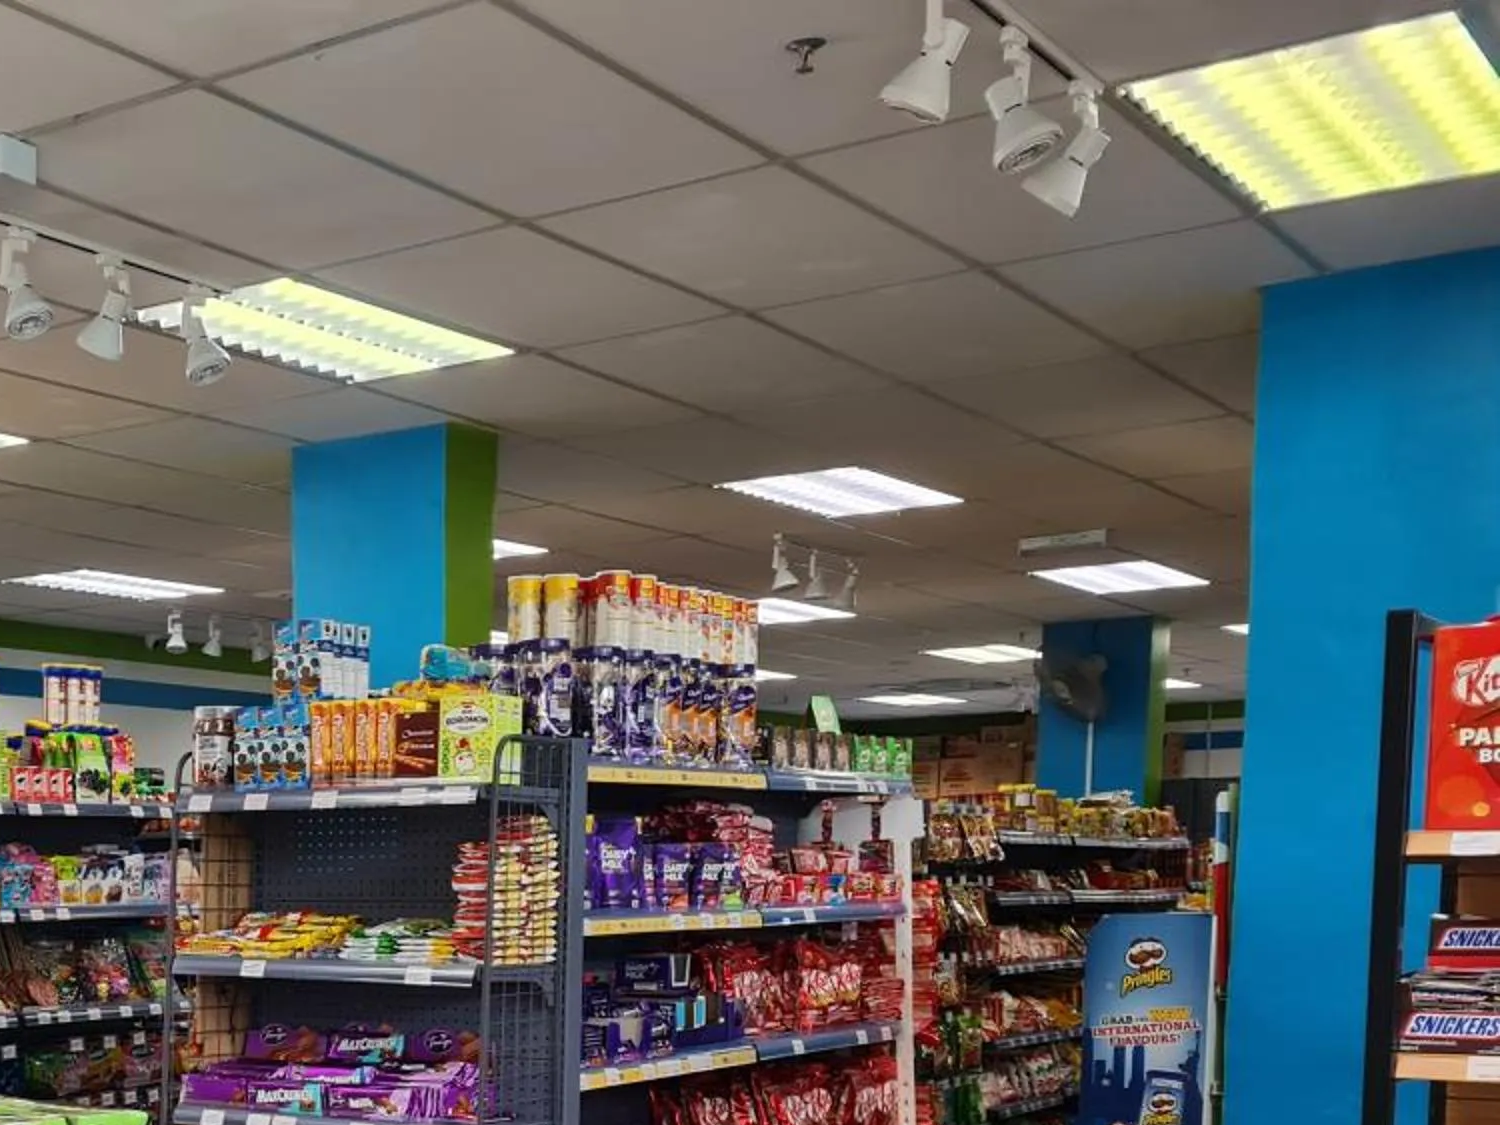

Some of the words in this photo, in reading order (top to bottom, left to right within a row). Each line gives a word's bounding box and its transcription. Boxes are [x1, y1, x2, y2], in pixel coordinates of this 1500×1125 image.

[1121, 967, 1172, 997] Pringles
[1093, 1020, 1201, 1037] INTERNATIONAL
[1411, 1015, 1500, 1036] SNICKERS
